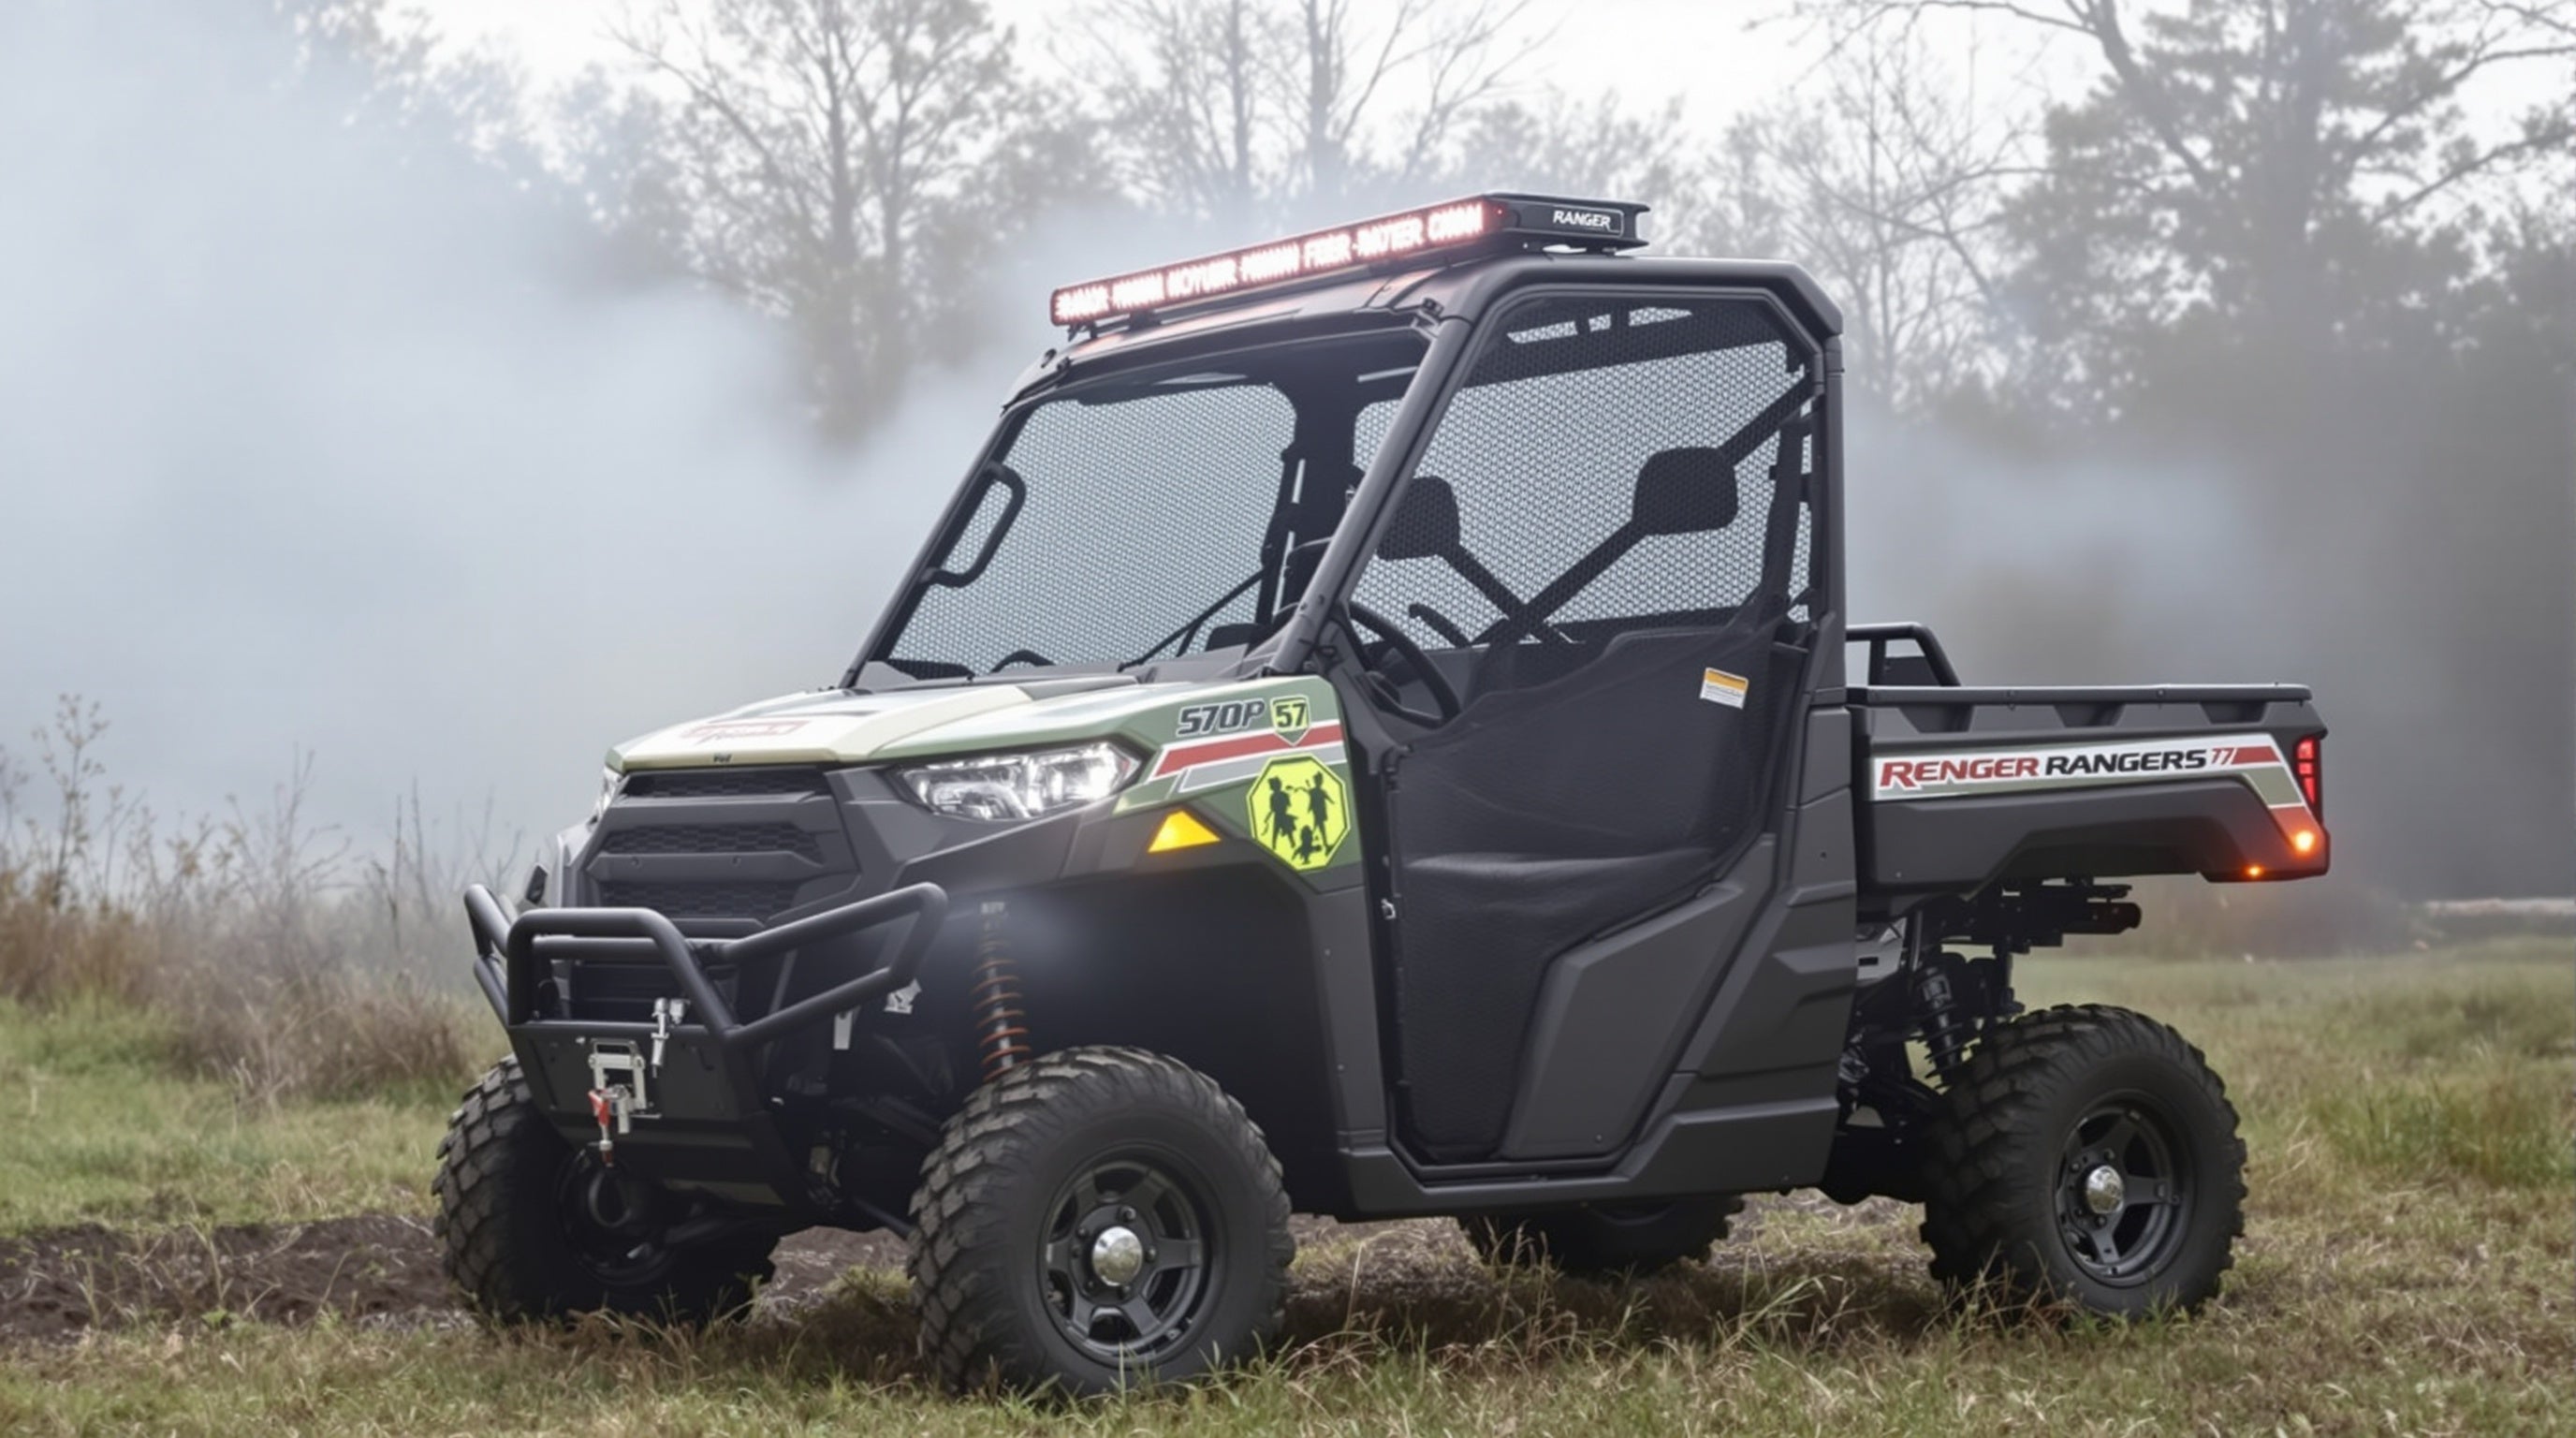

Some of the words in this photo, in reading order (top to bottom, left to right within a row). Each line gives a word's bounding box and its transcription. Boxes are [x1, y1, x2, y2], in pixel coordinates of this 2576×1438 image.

[1553, 210, 1611, 228] RANGER
[1275, 702, 1307, 728] 57
[1880, 756, 2040, 787] RENGER
[2045, 749, 2207, 775] RANGERS
